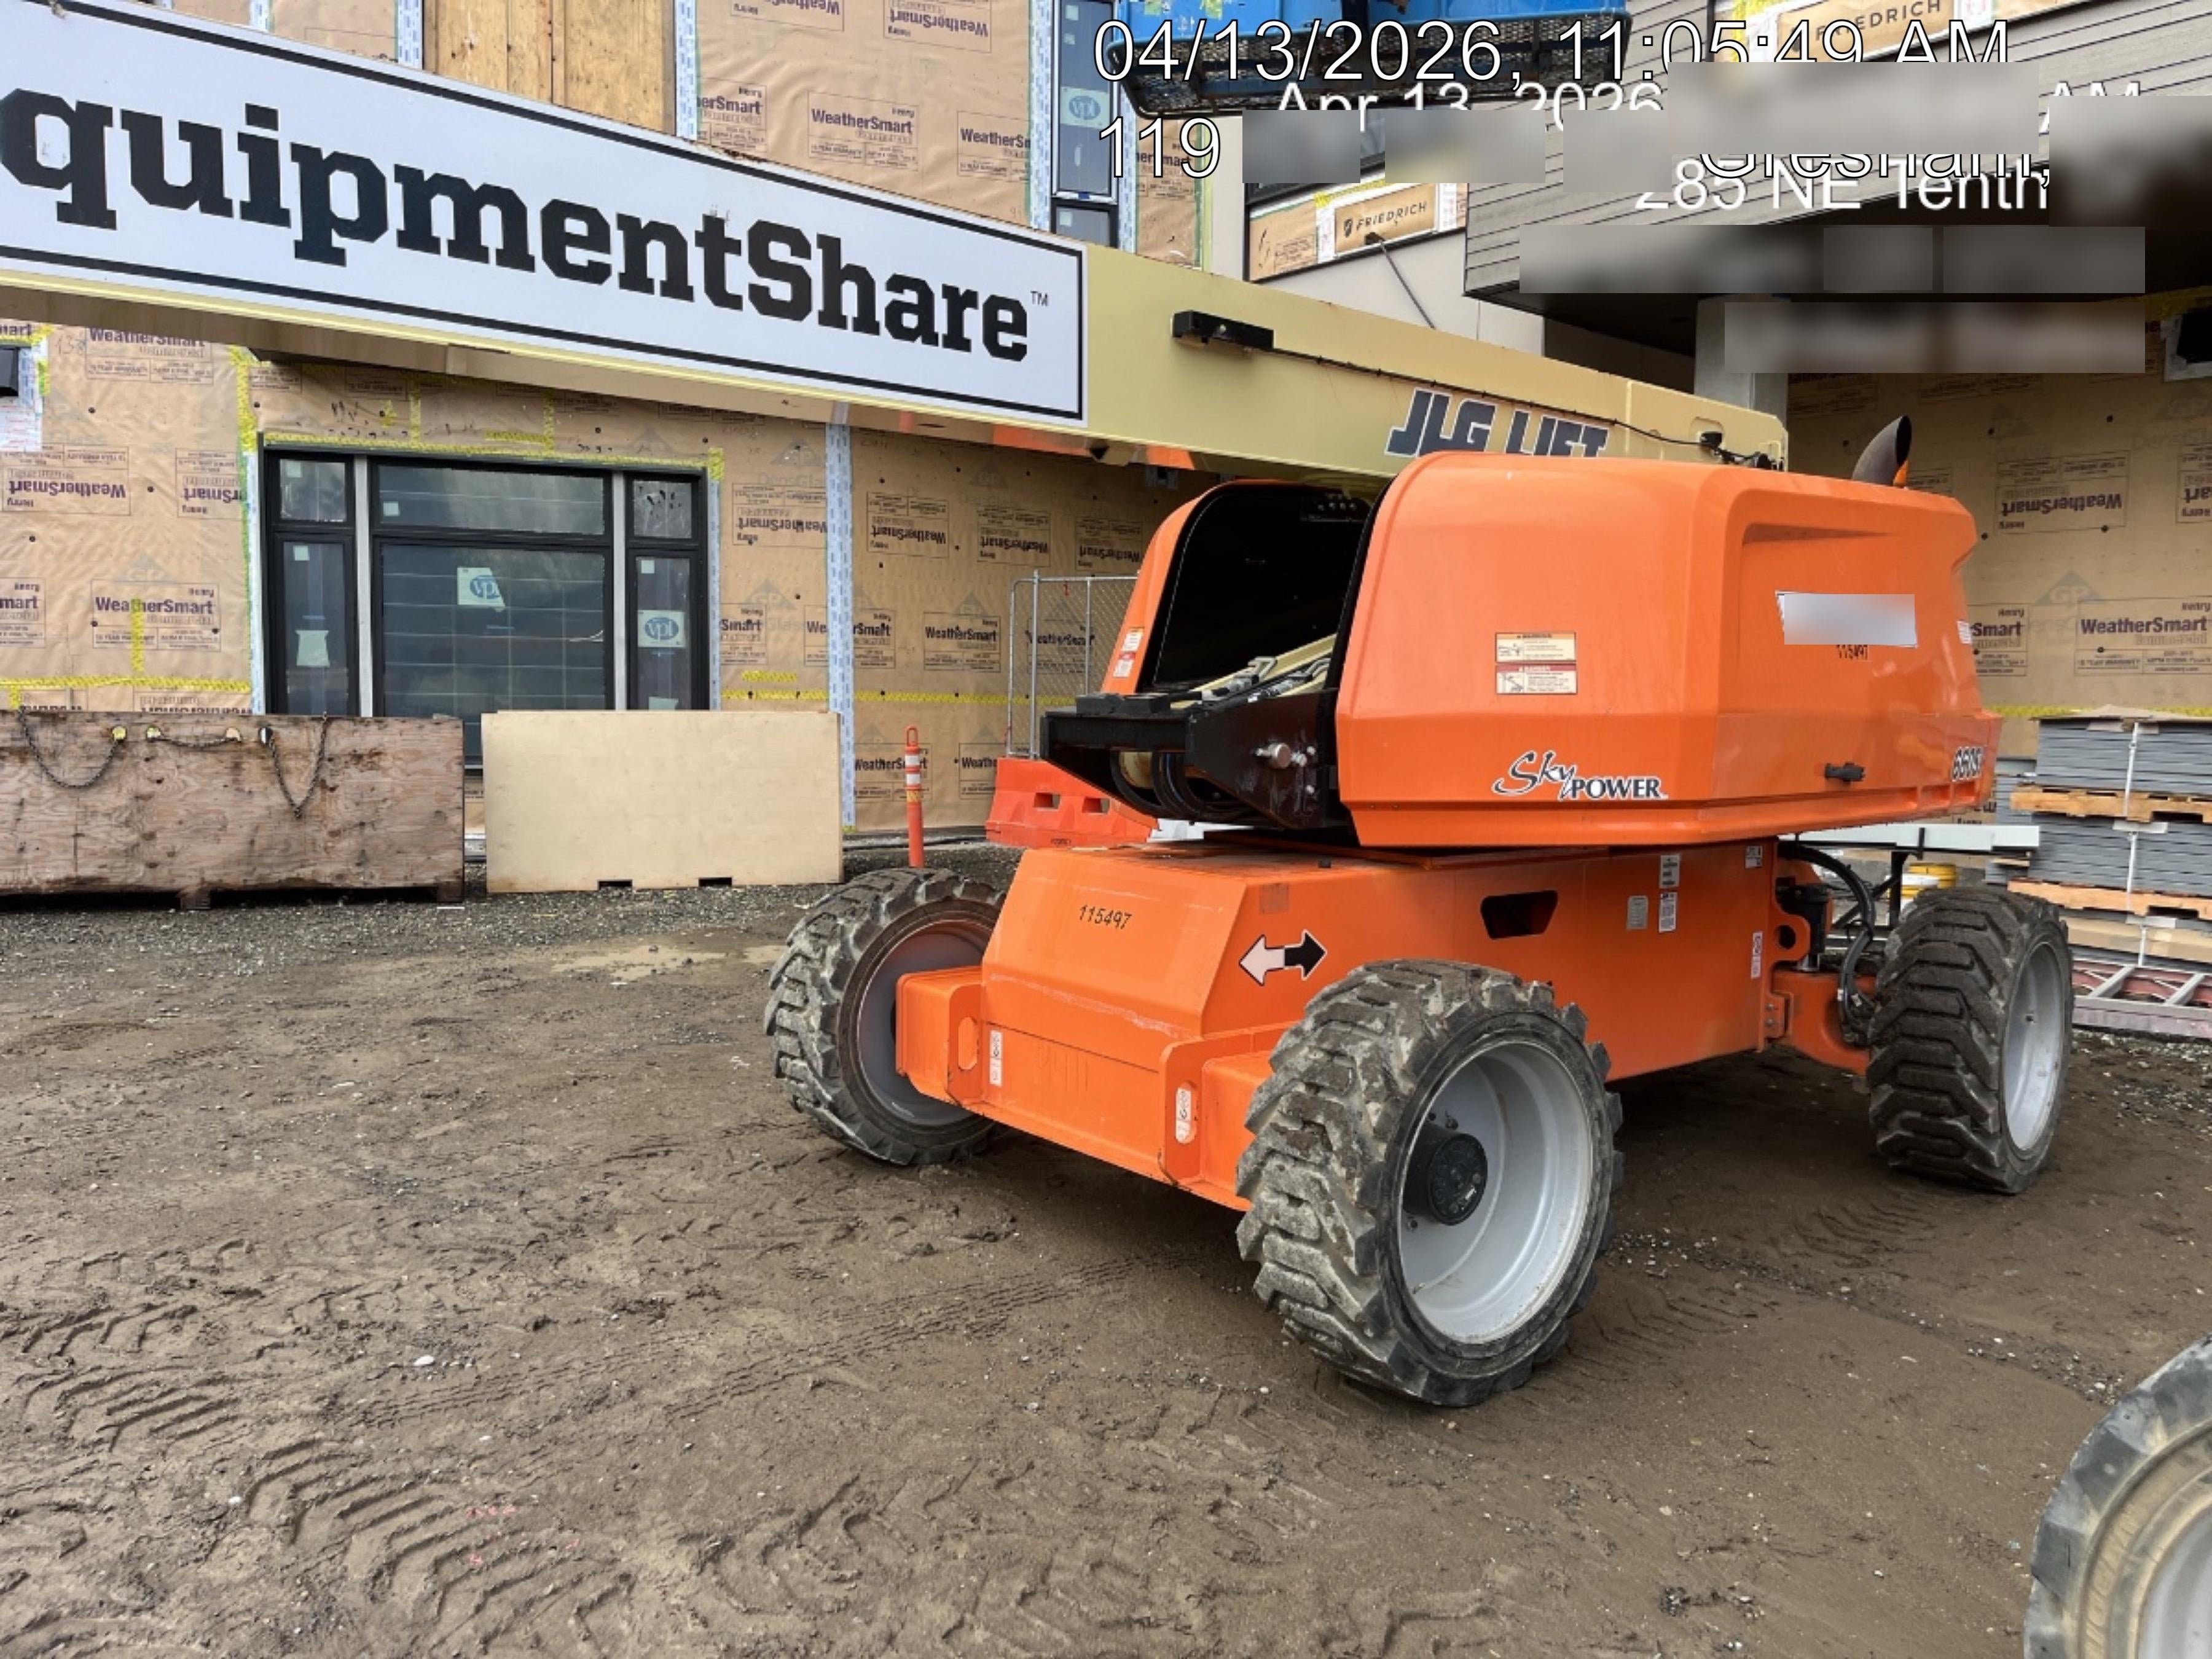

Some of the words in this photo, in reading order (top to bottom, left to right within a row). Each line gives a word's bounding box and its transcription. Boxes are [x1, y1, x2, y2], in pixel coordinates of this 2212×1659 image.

[890, 9, 989, 37] WeatherSmart
[1816, 0, 1940, 41] FEDRICH
[811, 108, 914, 134] WeatherSmart
[0, 88, 1027, 361] quipmentShare
[1356, 202, 1427, 231] FRIEDRICH
[1384, 387, 1497, 457] JLG
[1505, 408, 1609, 457] LIFT
[9, 480, 126, 498] WeatherSmart
[2002, 493, 2122, 517] WeatherSmart
[870, 525, 947, 545] WeatherSmart
[925, 626, 996, 641] WeatherSmart
[2081, 616, 2208, 635] WeatherSmart
[1080, 904, 1132, 930] 115497
